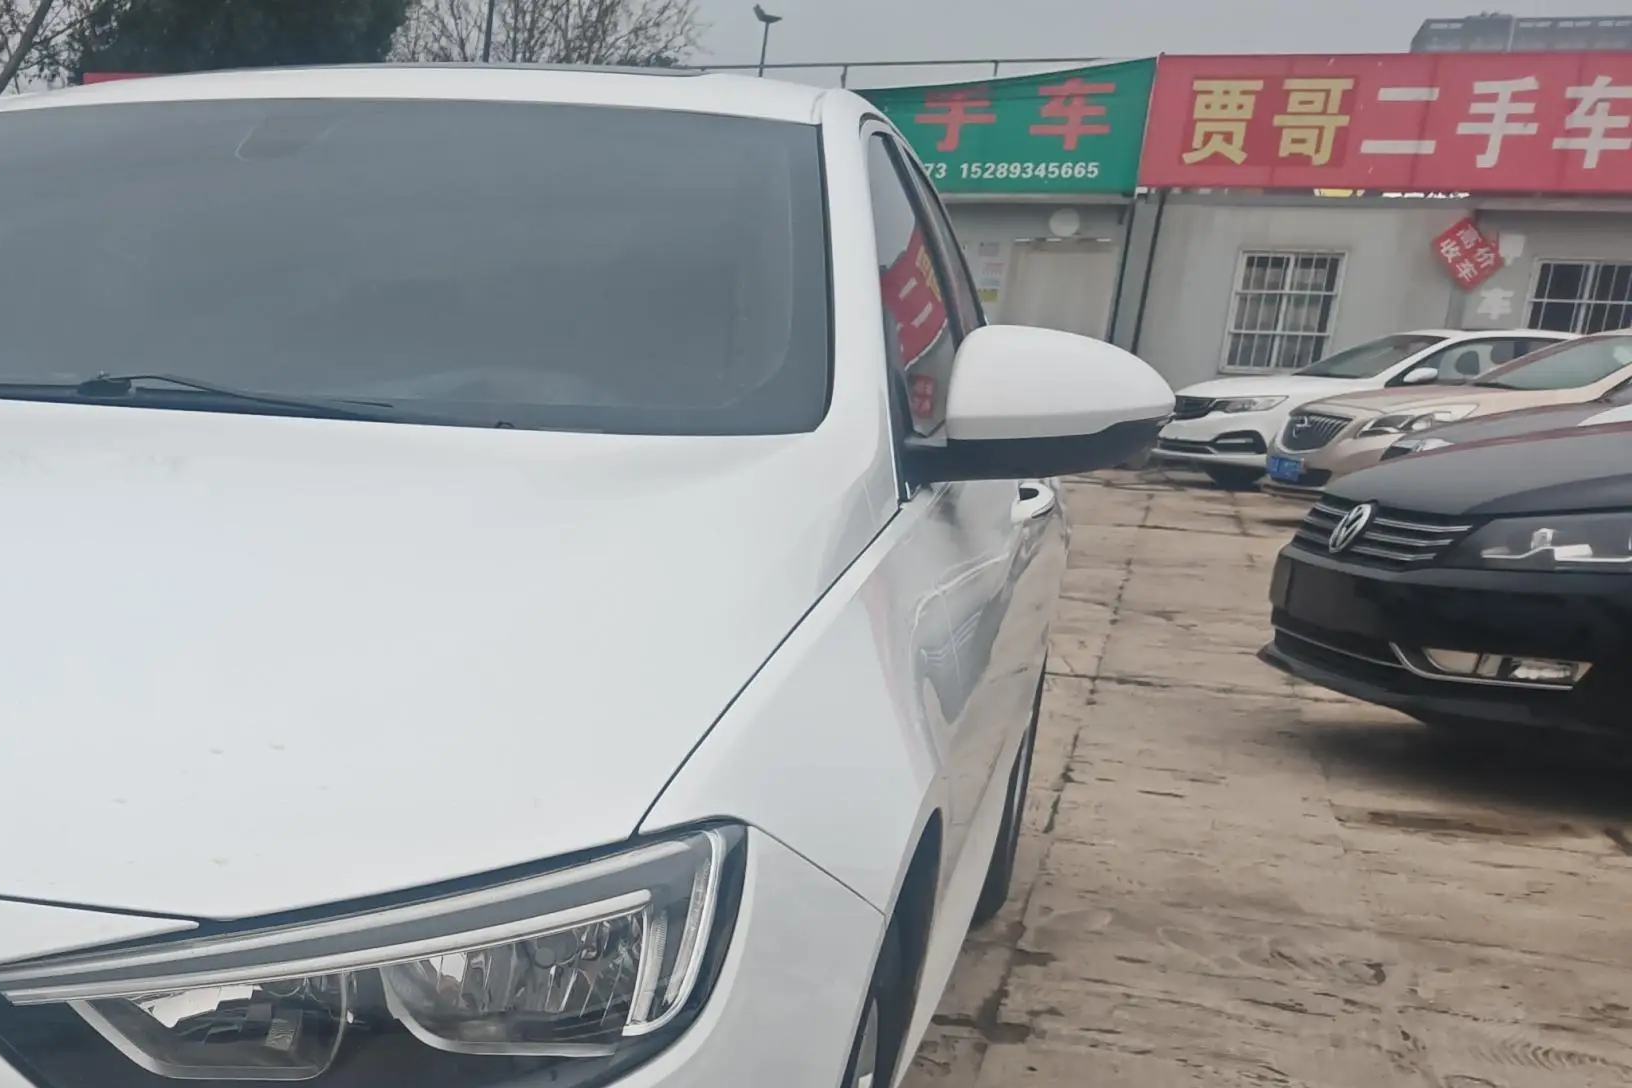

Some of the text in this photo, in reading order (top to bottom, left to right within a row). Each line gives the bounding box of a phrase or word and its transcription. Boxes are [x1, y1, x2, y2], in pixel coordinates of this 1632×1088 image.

[1182, 75, 1632, 169] 贾哥二手车
[960, 162, 1100, 179] 15289345665
